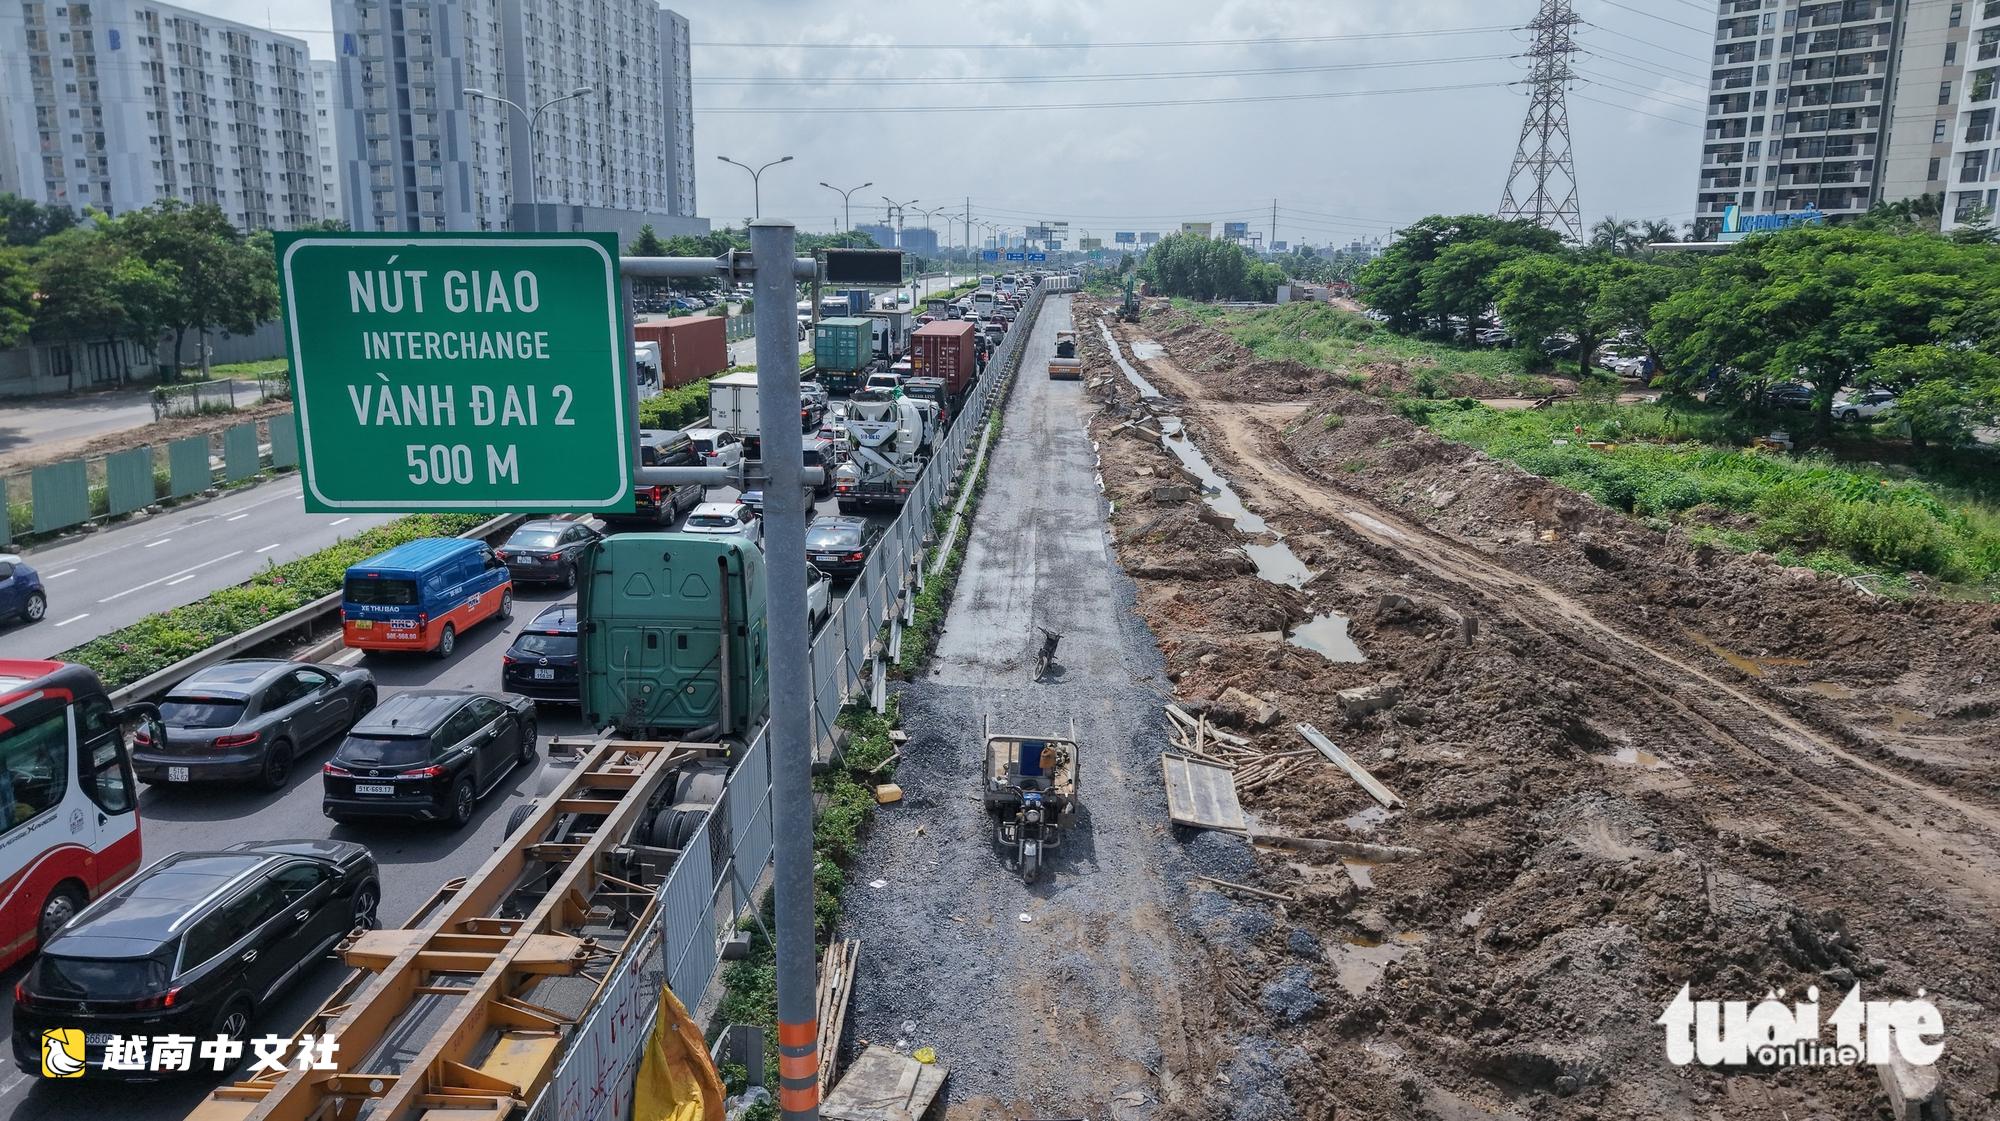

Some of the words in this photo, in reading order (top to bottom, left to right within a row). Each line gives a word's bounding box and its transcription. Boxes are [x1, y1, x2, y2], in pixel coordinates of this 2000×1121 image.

[348, 254, 428, 313] NÚT
[443, 270, 539, 313] GIAO
[363, 331, 550, 360] INTERCHANGE
[347, 372, 456, 426] VÀNH
[469, 384, 538, 426] ĐAI
[552, 384, 576, 426] 2
[406, 444, 474, 485] 500
[486, 444, 519, 485] M
